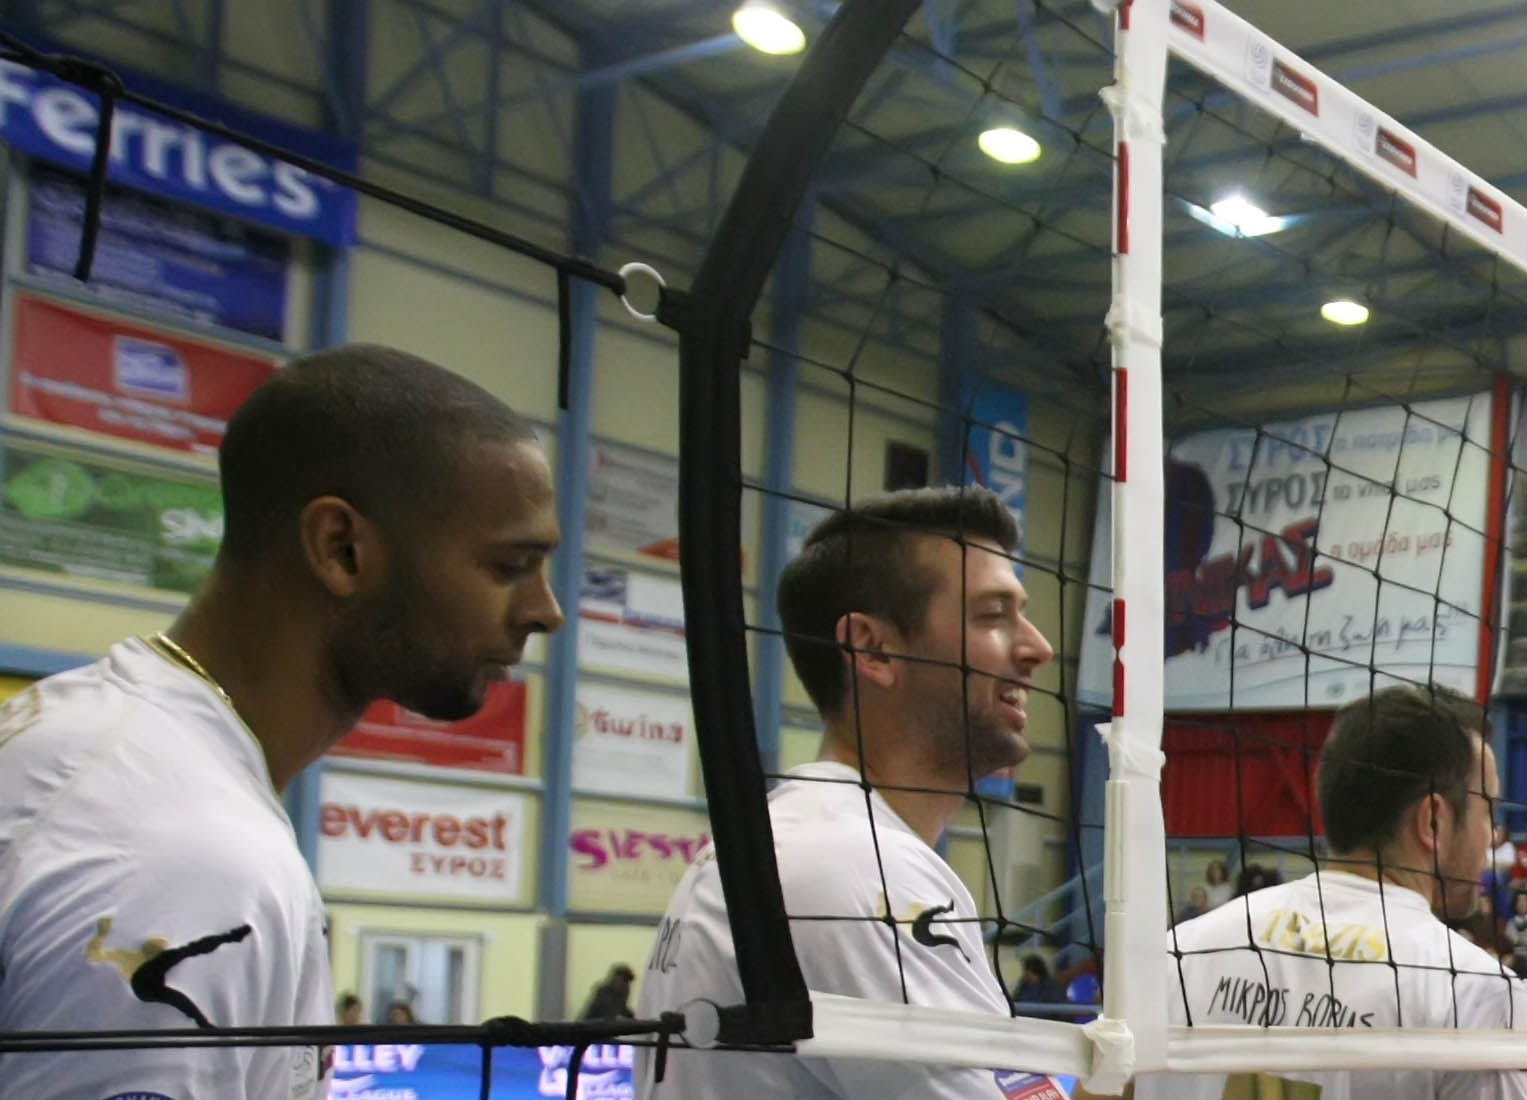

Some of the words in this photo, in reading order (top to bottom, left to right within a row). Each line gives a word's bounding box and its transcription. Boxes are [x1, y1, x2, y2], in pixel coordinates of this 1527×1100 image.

[320, 803, 509, 851] everest
[409, 852, 507, 879] ΣΥΡΟΣ
[334, 1045, 425, 1072] LLEY
